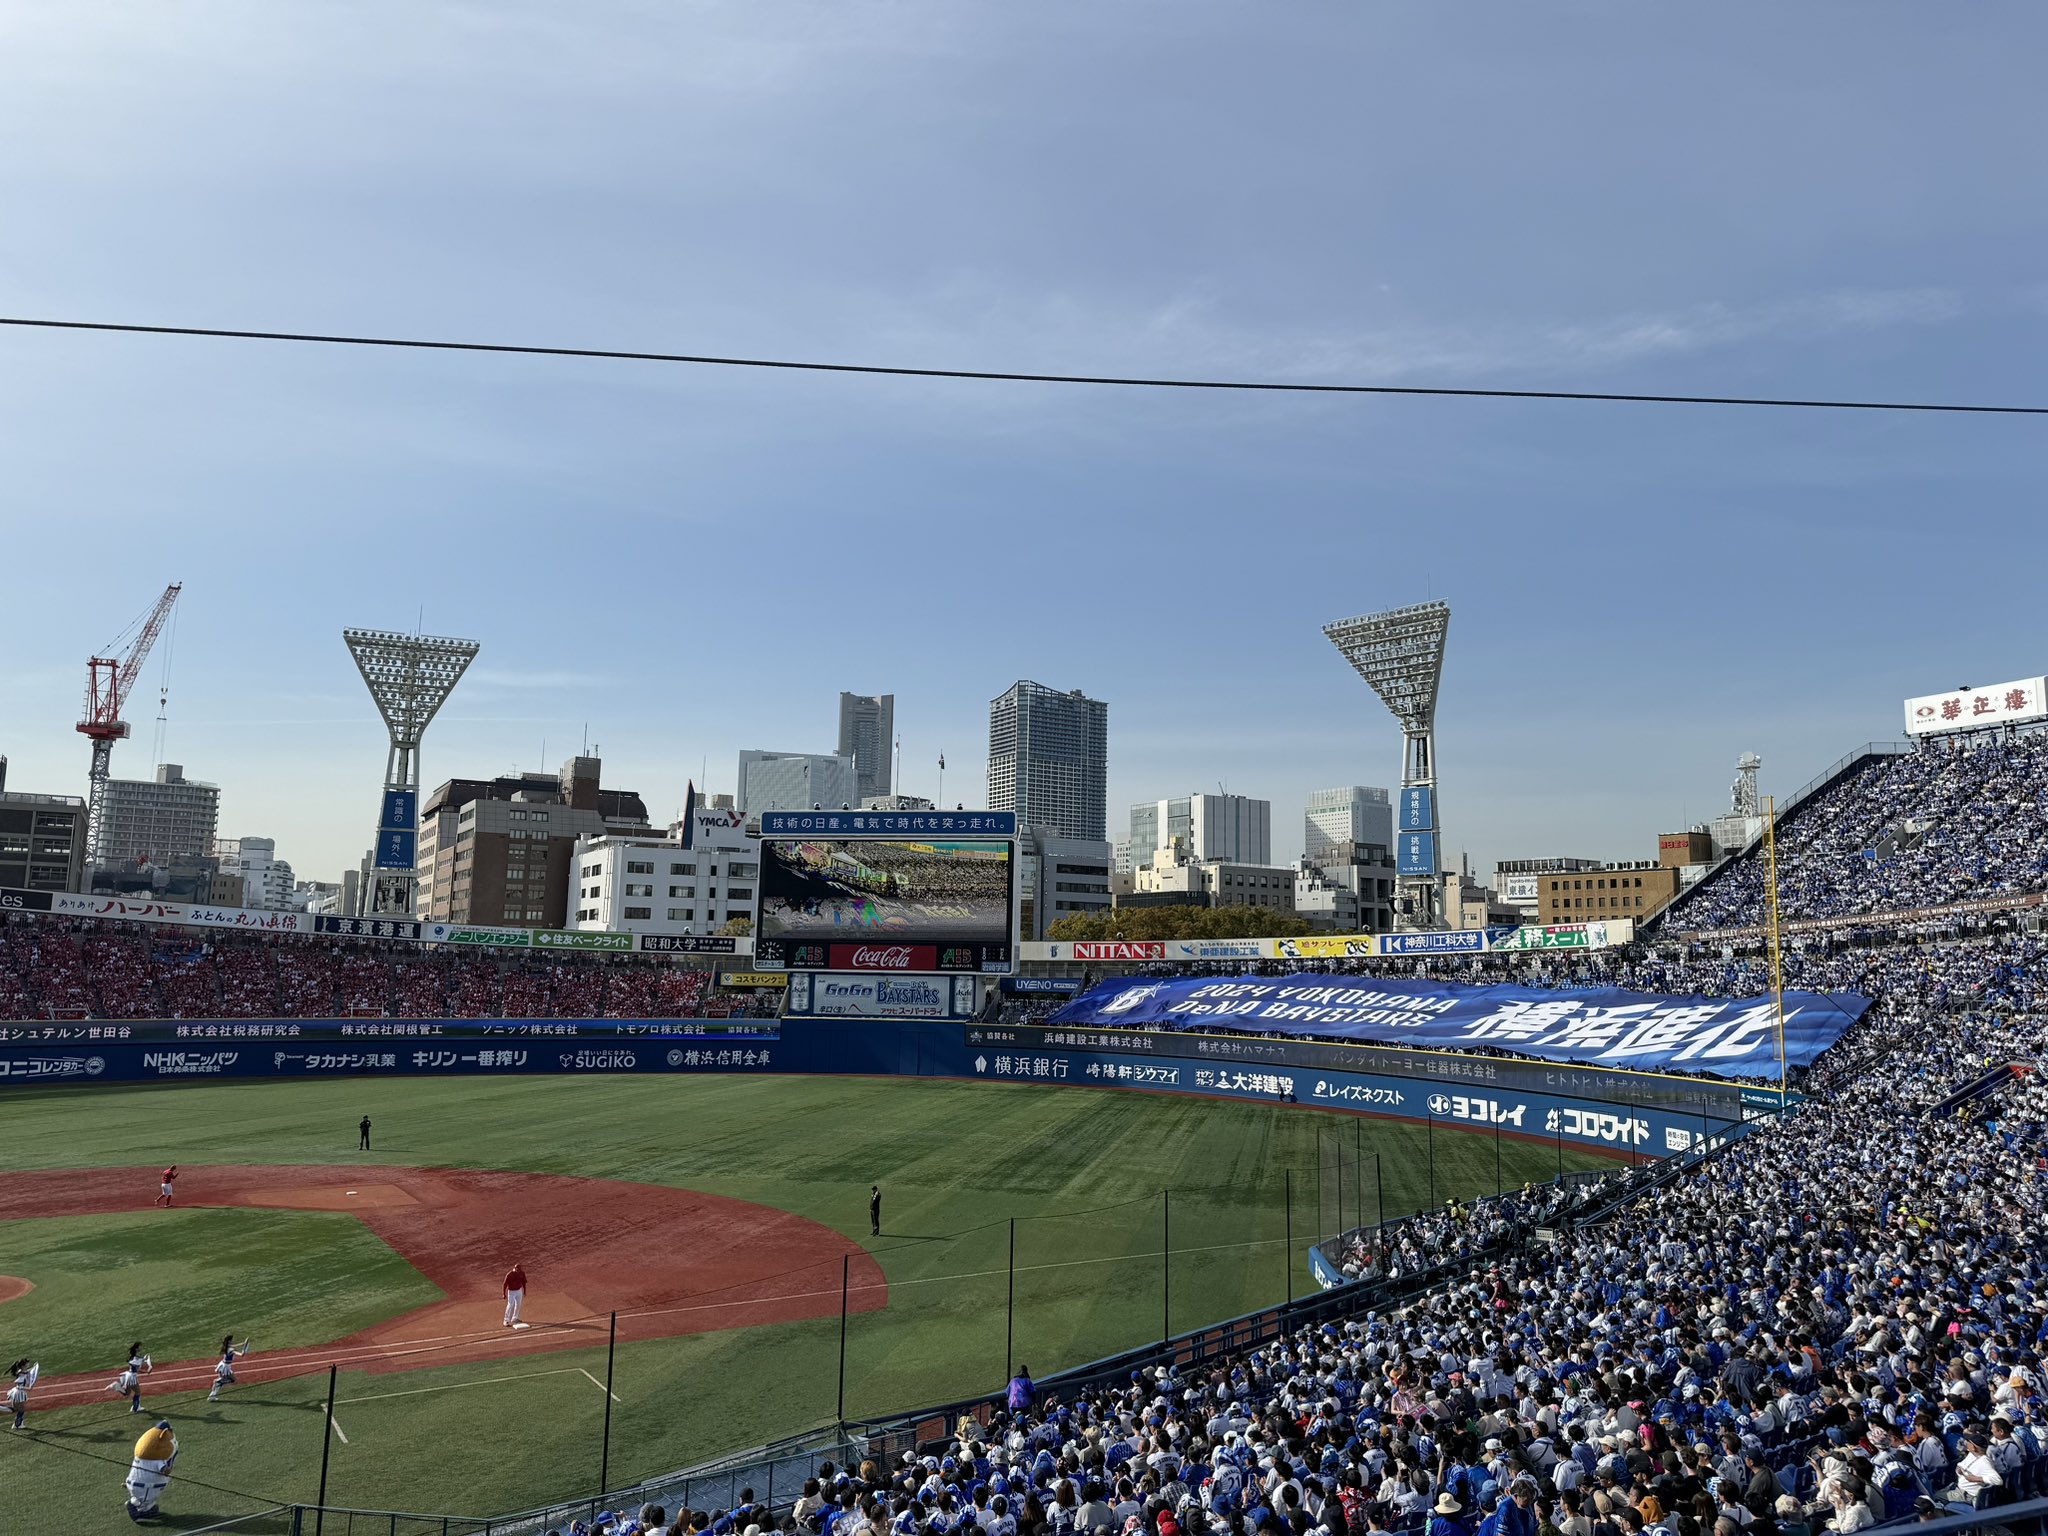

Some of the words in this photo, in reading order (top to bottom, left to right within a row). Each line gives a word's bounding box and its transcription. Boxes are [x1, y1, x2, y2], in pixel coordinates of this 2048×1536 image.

[394, 798, 404, 823] 常識の
[1410, 791, 1419, 826] 規格外の
[698, 816, 729, 828] YMCA
[772, 817, 1005, 829] 技術の日産。電気で時代を突っ走れ。
[391, 835, 401, 858] 場外へ
[1410, 836, 1420, 864] 挑戦を
[0, 893, 23, 907] es
[59, 899, 95, 910] ありあけ
[95, 901, 180, 917] ハーバー
[338, 919, 415, 938] 京濱港運
[553, 934, 629, 948] 住友ベークライト
[645, 937, 697, 951] 昭和大学
[1404, 933, 1478, 949] 神奈川工科大学
[852, 946, 914, 968] Coca-Cola
[1075, 944, 1147, 959] NITTAN
[736, 975, 777, 984] コスモバンク
[1016, 980, 1051, 990] UYENO
[876, 980, 940, 1004] BAYSTARS
[1188, 983, 1273, 999] 2024
[1276, 986, 1460, 1013] YOKOHAMA
[899, 1006, 943, 1016] スーパードライ
[1167, 1000, 1260, 1016] DeNA
[1257, 1002, 1437, 1028] BAYSTARS
[176, 1024, 301, 1037] 株式会社税務研究会
[341, 1024, 443, 1036] 株式会社関根管工
[482, 1024, 578, 1035] ソニック株式会社
[616, 1024, 706, 1035] トモプロ株式会社
[987, 1032, 1015, 1041] 協賛各社
[1450, 999, 1805, 1061] 横浜進化
[1044, 1032, 1153, 1049] 浜崎建設工業株式会社
[1198, 1041, 1286, 1057] 株式会社ハマナス
[143, 1052, 239, 1067] NHKニッパツ
[305, 1053, 396, 1069] タカナシ乳業
[576, 1056, 636, 1068] SUGIKO
[684, 1049, 771, 1066] 横浜信用金庫
[158, 1065, 221, 1074] 日本発条株式会社
[994, 1055, 1069, 1078] 横浜銀行
[1086, 1062, 1133, 1079] 崎陽軒
[1135, 1066, 1178, 1083] シウマイ
[1196, 1078, 1214, 1087] グループ
[1233, 1071, 1294, 1095] 大洋建設
[1329, 1083, 1405, 1105] レイズネクスト
[1452, 1096, 1527, 1127] ヨコレイ
[1563, 1108, 1651, 1146] コロワイド
